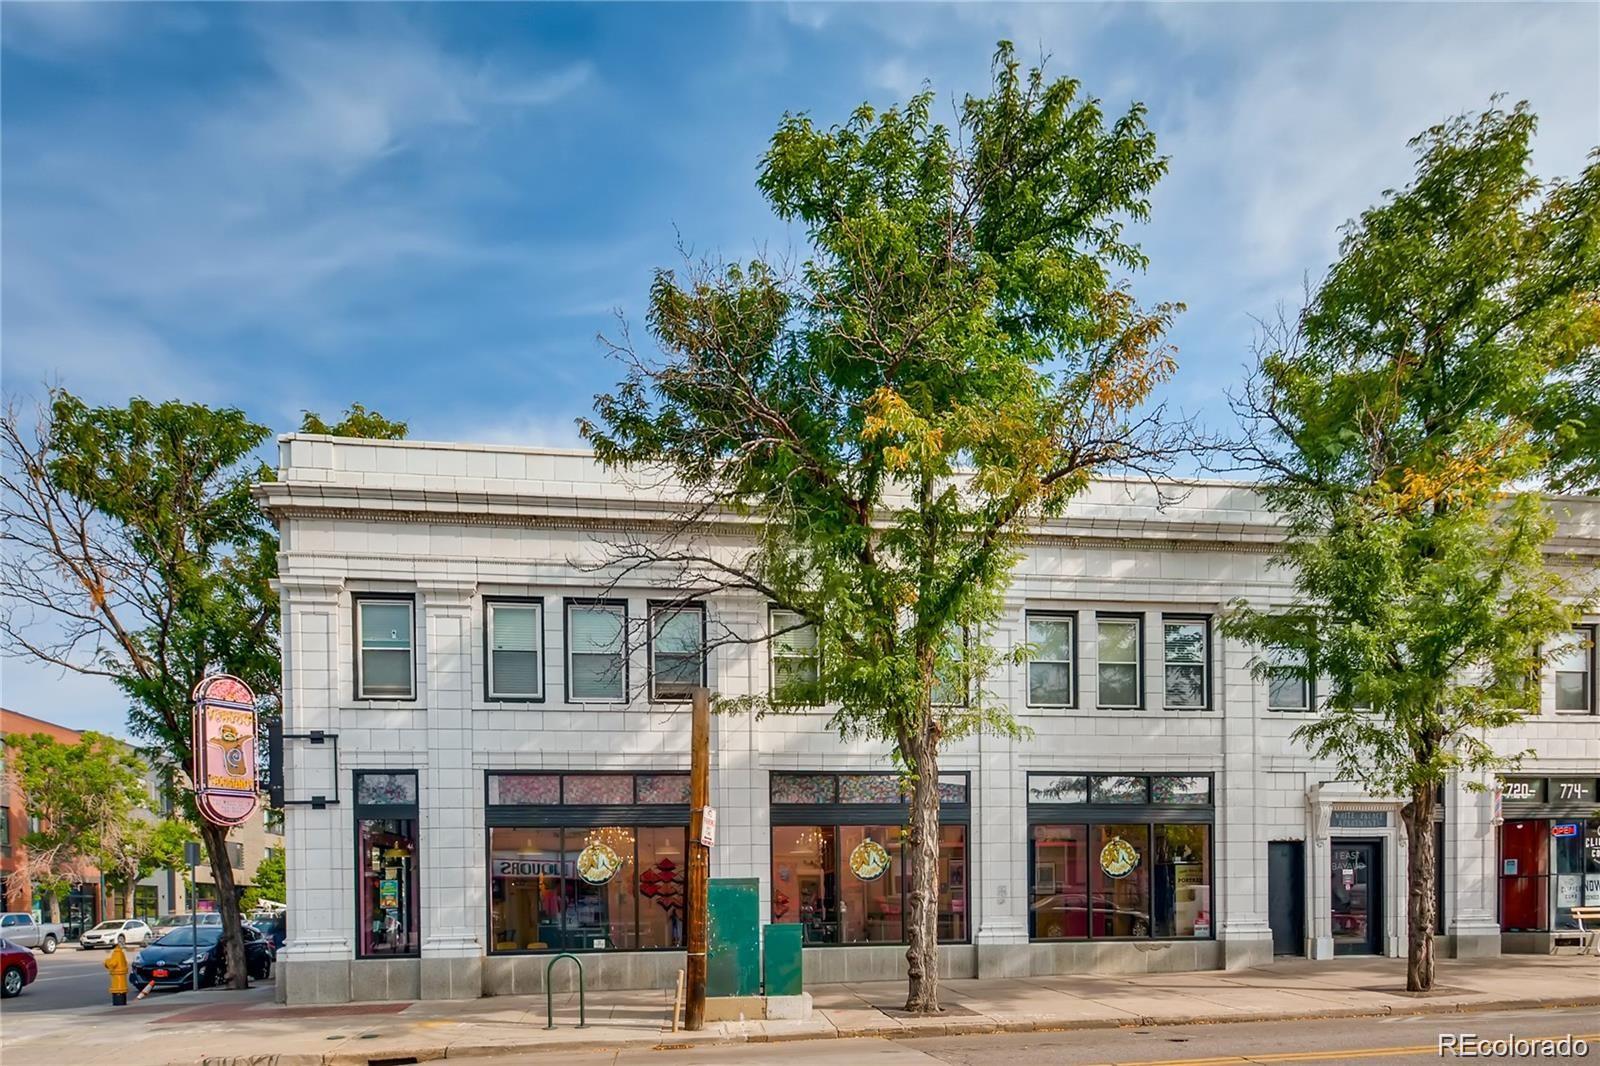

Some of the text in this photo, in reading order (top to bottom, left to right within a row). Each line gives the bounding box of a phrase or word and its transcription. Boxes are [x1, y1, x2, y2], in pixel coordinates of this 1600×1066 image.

[1560, 783, 1589, 799] 774-
[1552, 826, 1574, 835] OPEN
[1340, 851, 1361, 860] EAST
